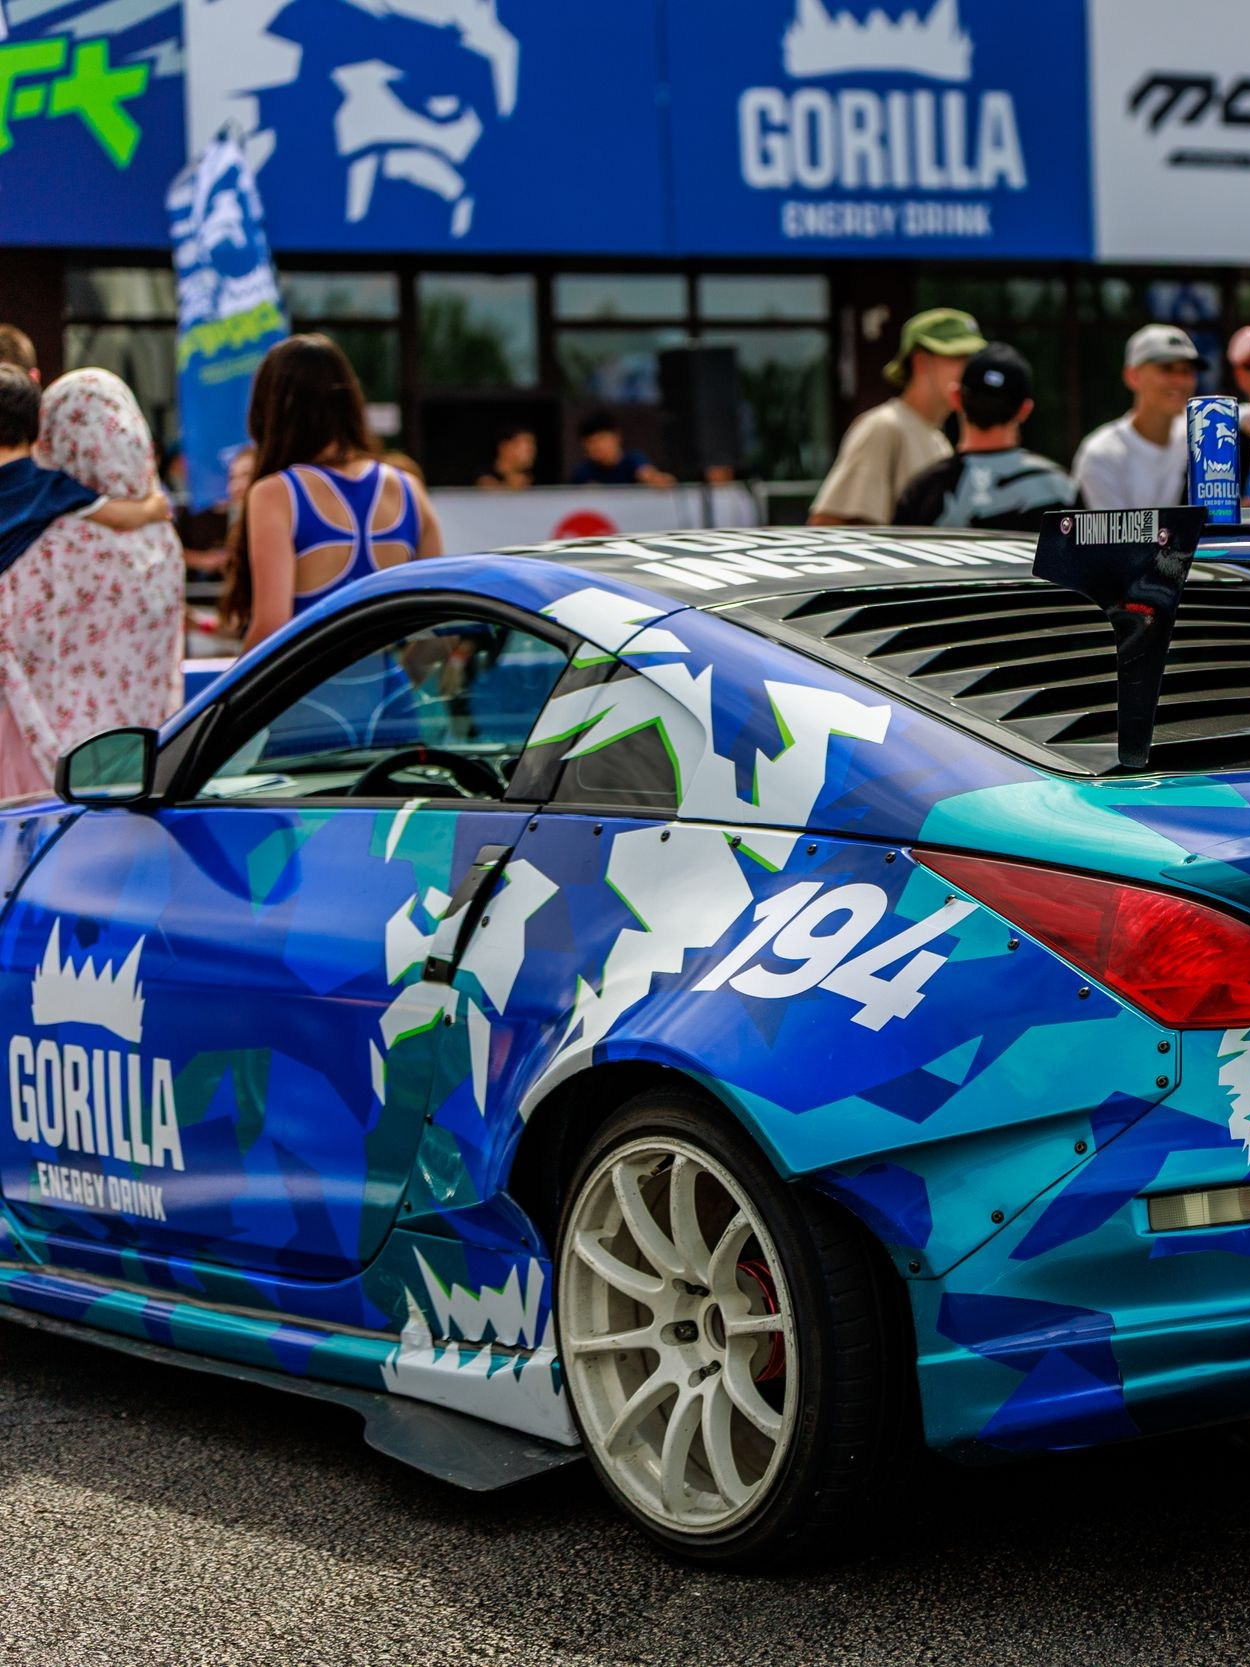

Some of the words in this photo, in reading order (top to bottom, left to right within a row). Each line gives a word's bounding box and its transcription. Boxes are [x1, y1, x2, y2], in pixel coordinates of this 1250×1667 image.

[738, 87, 1028, 190] GORILLA
[782, 201, 897, 238] ENERGY
[903, 202, 992, 237] DRINK
[1198, 482, 1241, 499] GORILLA
[1075, 512, 1108, 545] TURNIN
[1110, 511, 1141, 544] HEADS
[634, 538, 1037, 590] INSTIN
[690, 881, 980, 1032] 194
[9, 1035, 185, 1171] GORILLA
[37, 1162, 105, 1208] ENERGY
[108, 1176, 167, 1222] DRINK
